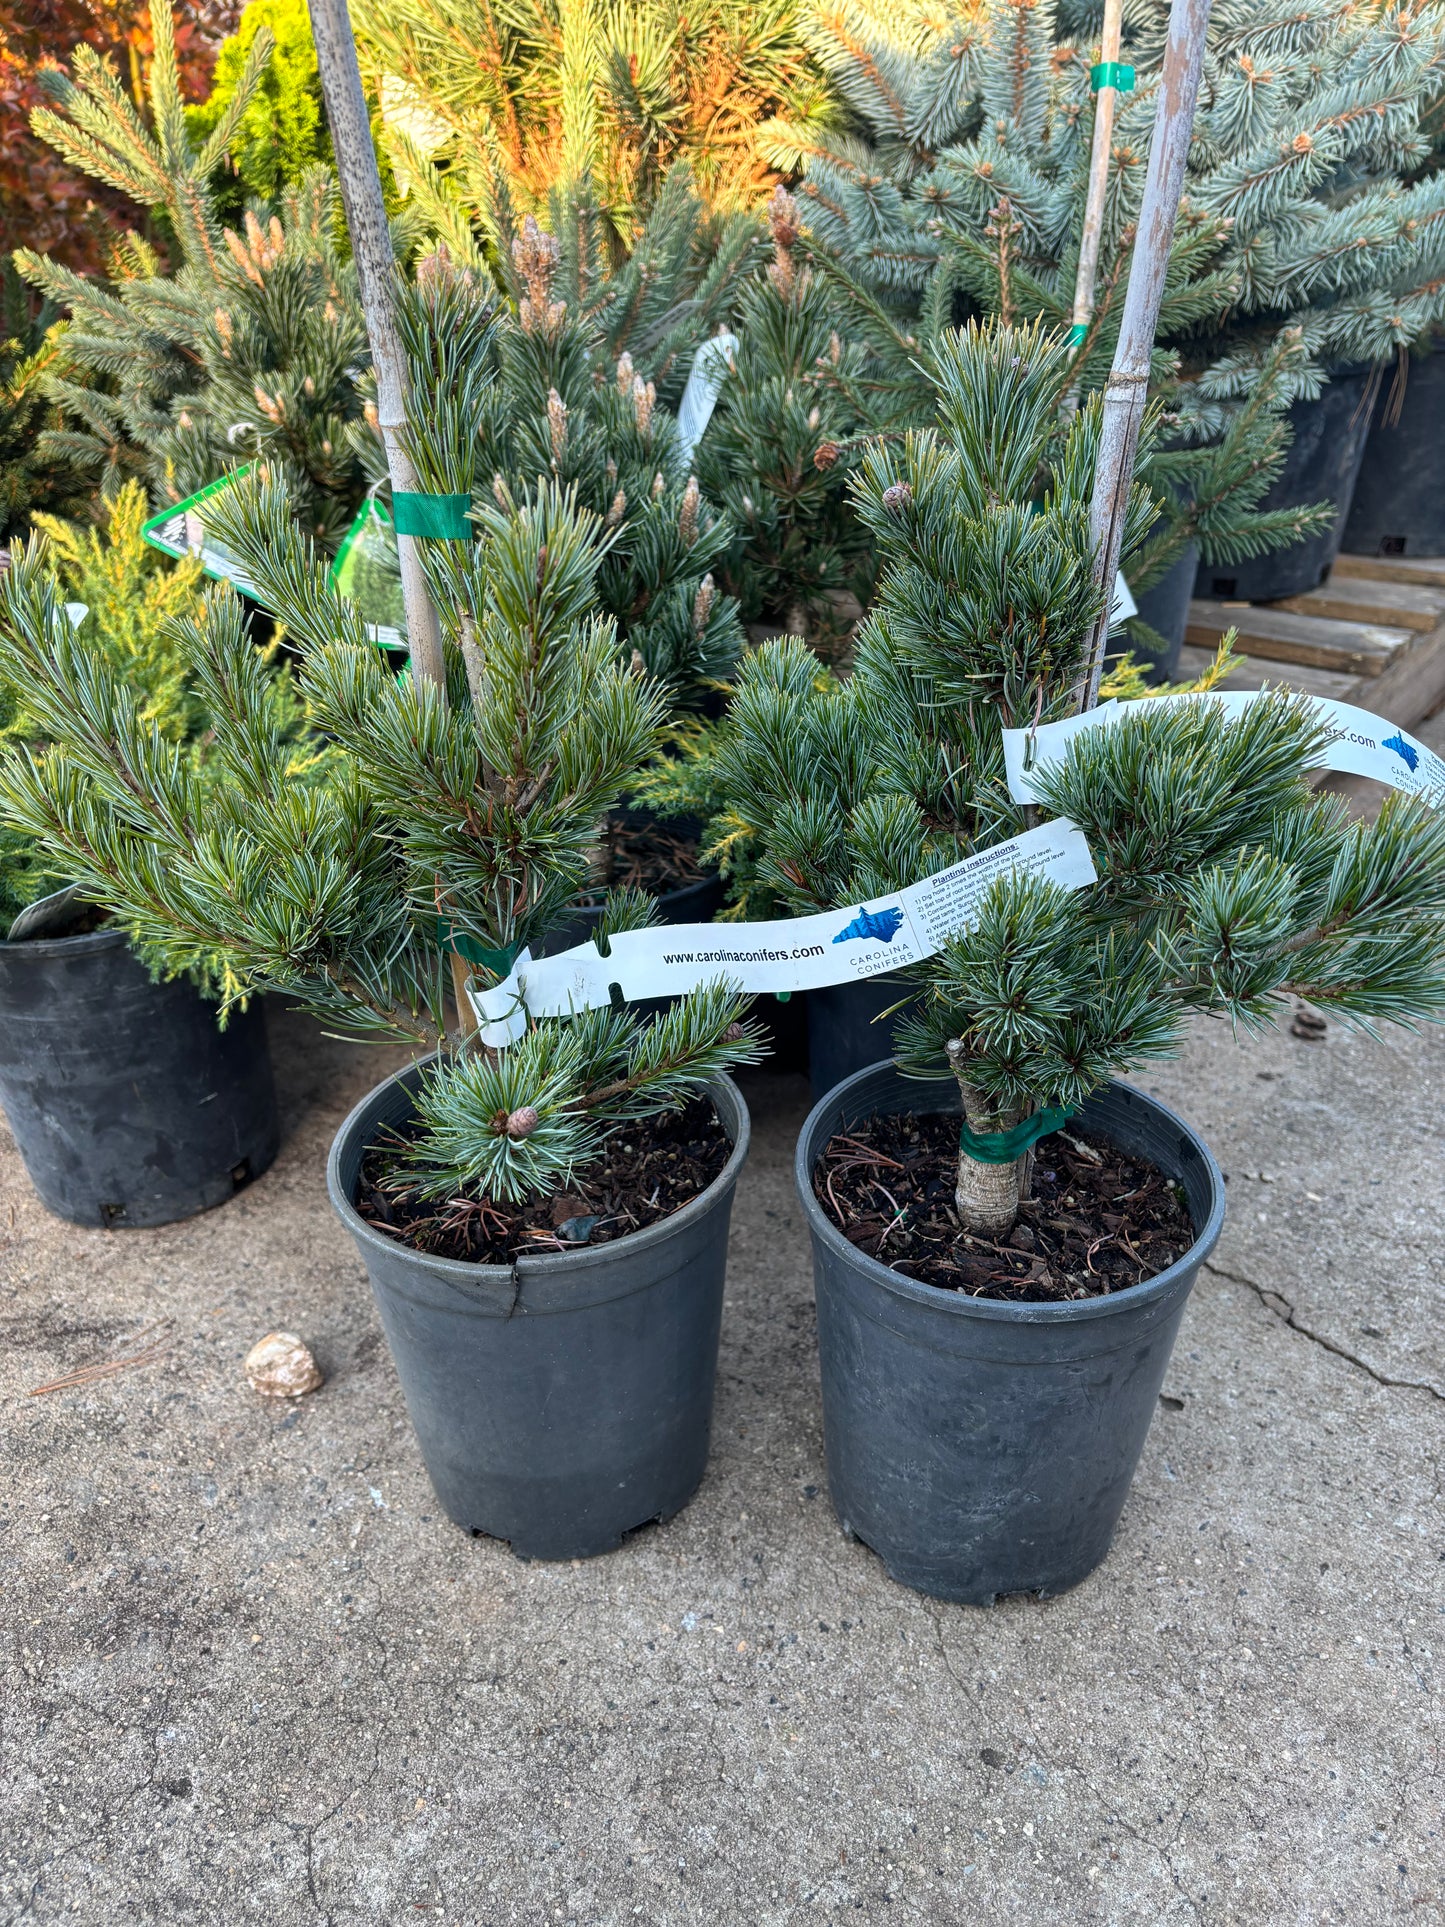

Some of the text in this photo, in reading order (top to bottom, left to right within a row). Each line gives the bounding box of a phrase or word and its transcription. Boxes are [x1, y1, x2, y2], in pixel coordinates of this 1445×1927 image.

[932, 867, 966, 887] Planting
[966, 843, 1019, 870] Instructions:
[915, 897, 921, 905] 1)
[922, 894, 932, 902] Dig
[933, 887, 945, 896] hole
[951, 877, 967, 888] times
[978, 865, 993, 874] width
[925, 900, 934, 909] Set
[935, 896, 945, 904] top
[952, 887, 964, 896] root
[965, 882, 975, 890] ball
[1016, 854, 1036, 866] ground
[927, 902, 952, 917] Combine
[953, 890, 975, 904] planting
[1029, 857, 1050, 869] ground
[930, 916, 940, 924] and
[933, 918, 950, 930] Water
[663, 944, 825, 965] www.carolinaconifers.com
[849, 943, 909, 966] CAROLINA
[857, 951, 915, 975] CONIFERS
